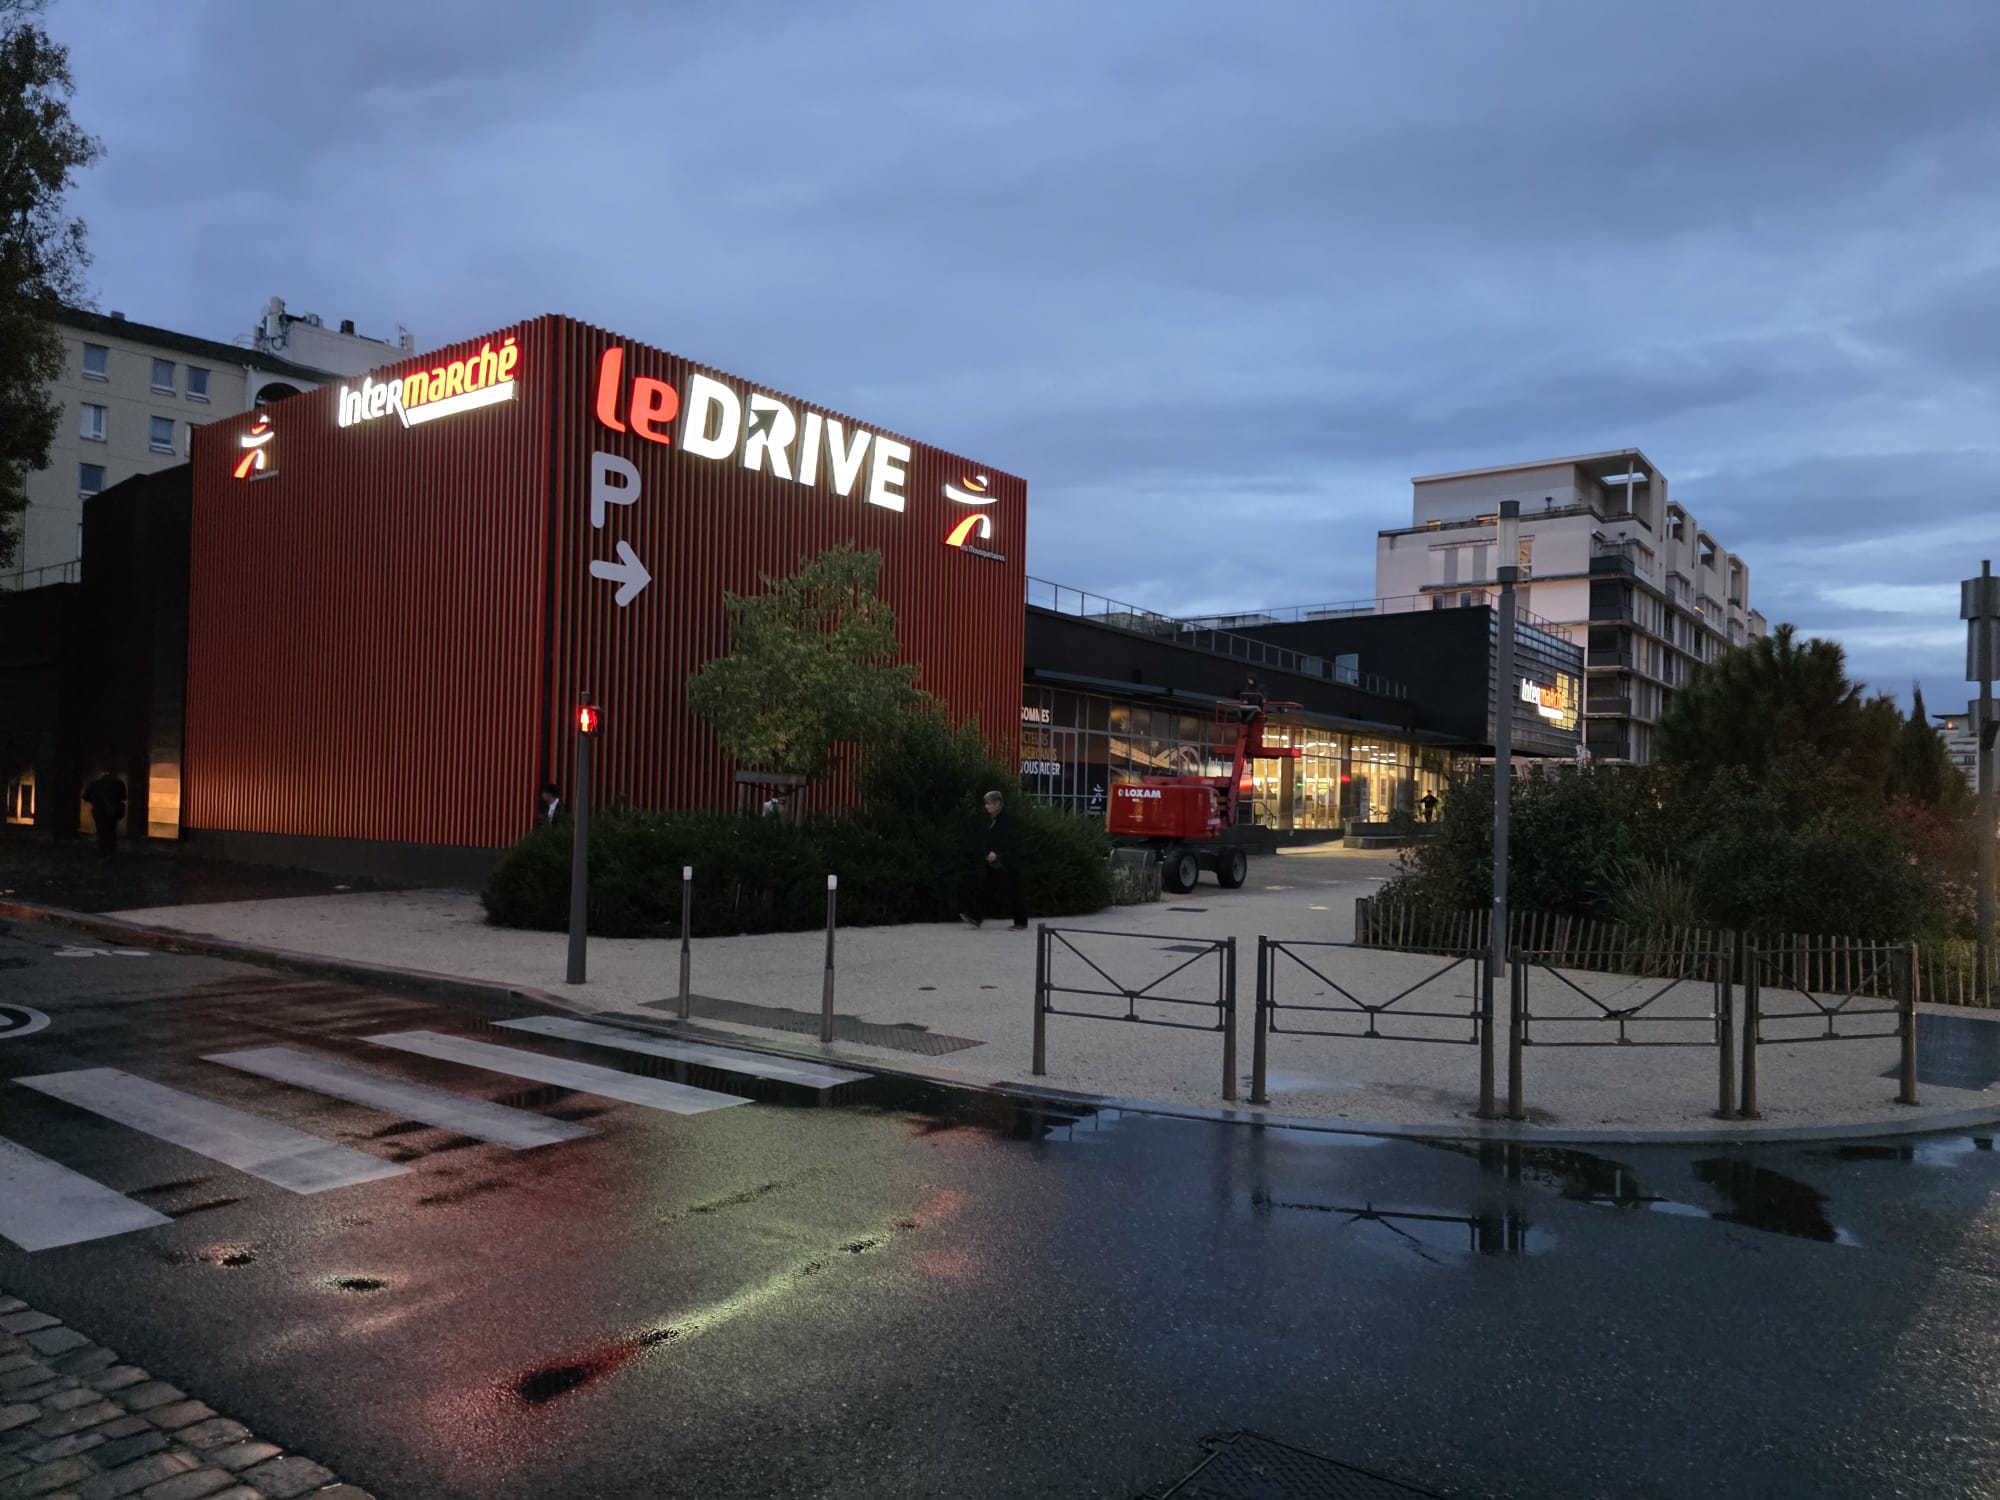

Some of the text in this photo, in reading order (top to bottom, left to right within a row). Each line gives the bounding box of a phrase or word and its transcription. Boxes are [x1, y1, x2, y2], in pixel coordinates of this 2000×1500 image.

[338, 337, 518, 429] Intermarché
[590, 451, 642, 529] P
[1125, 789, 1161, 798] LOXAM
